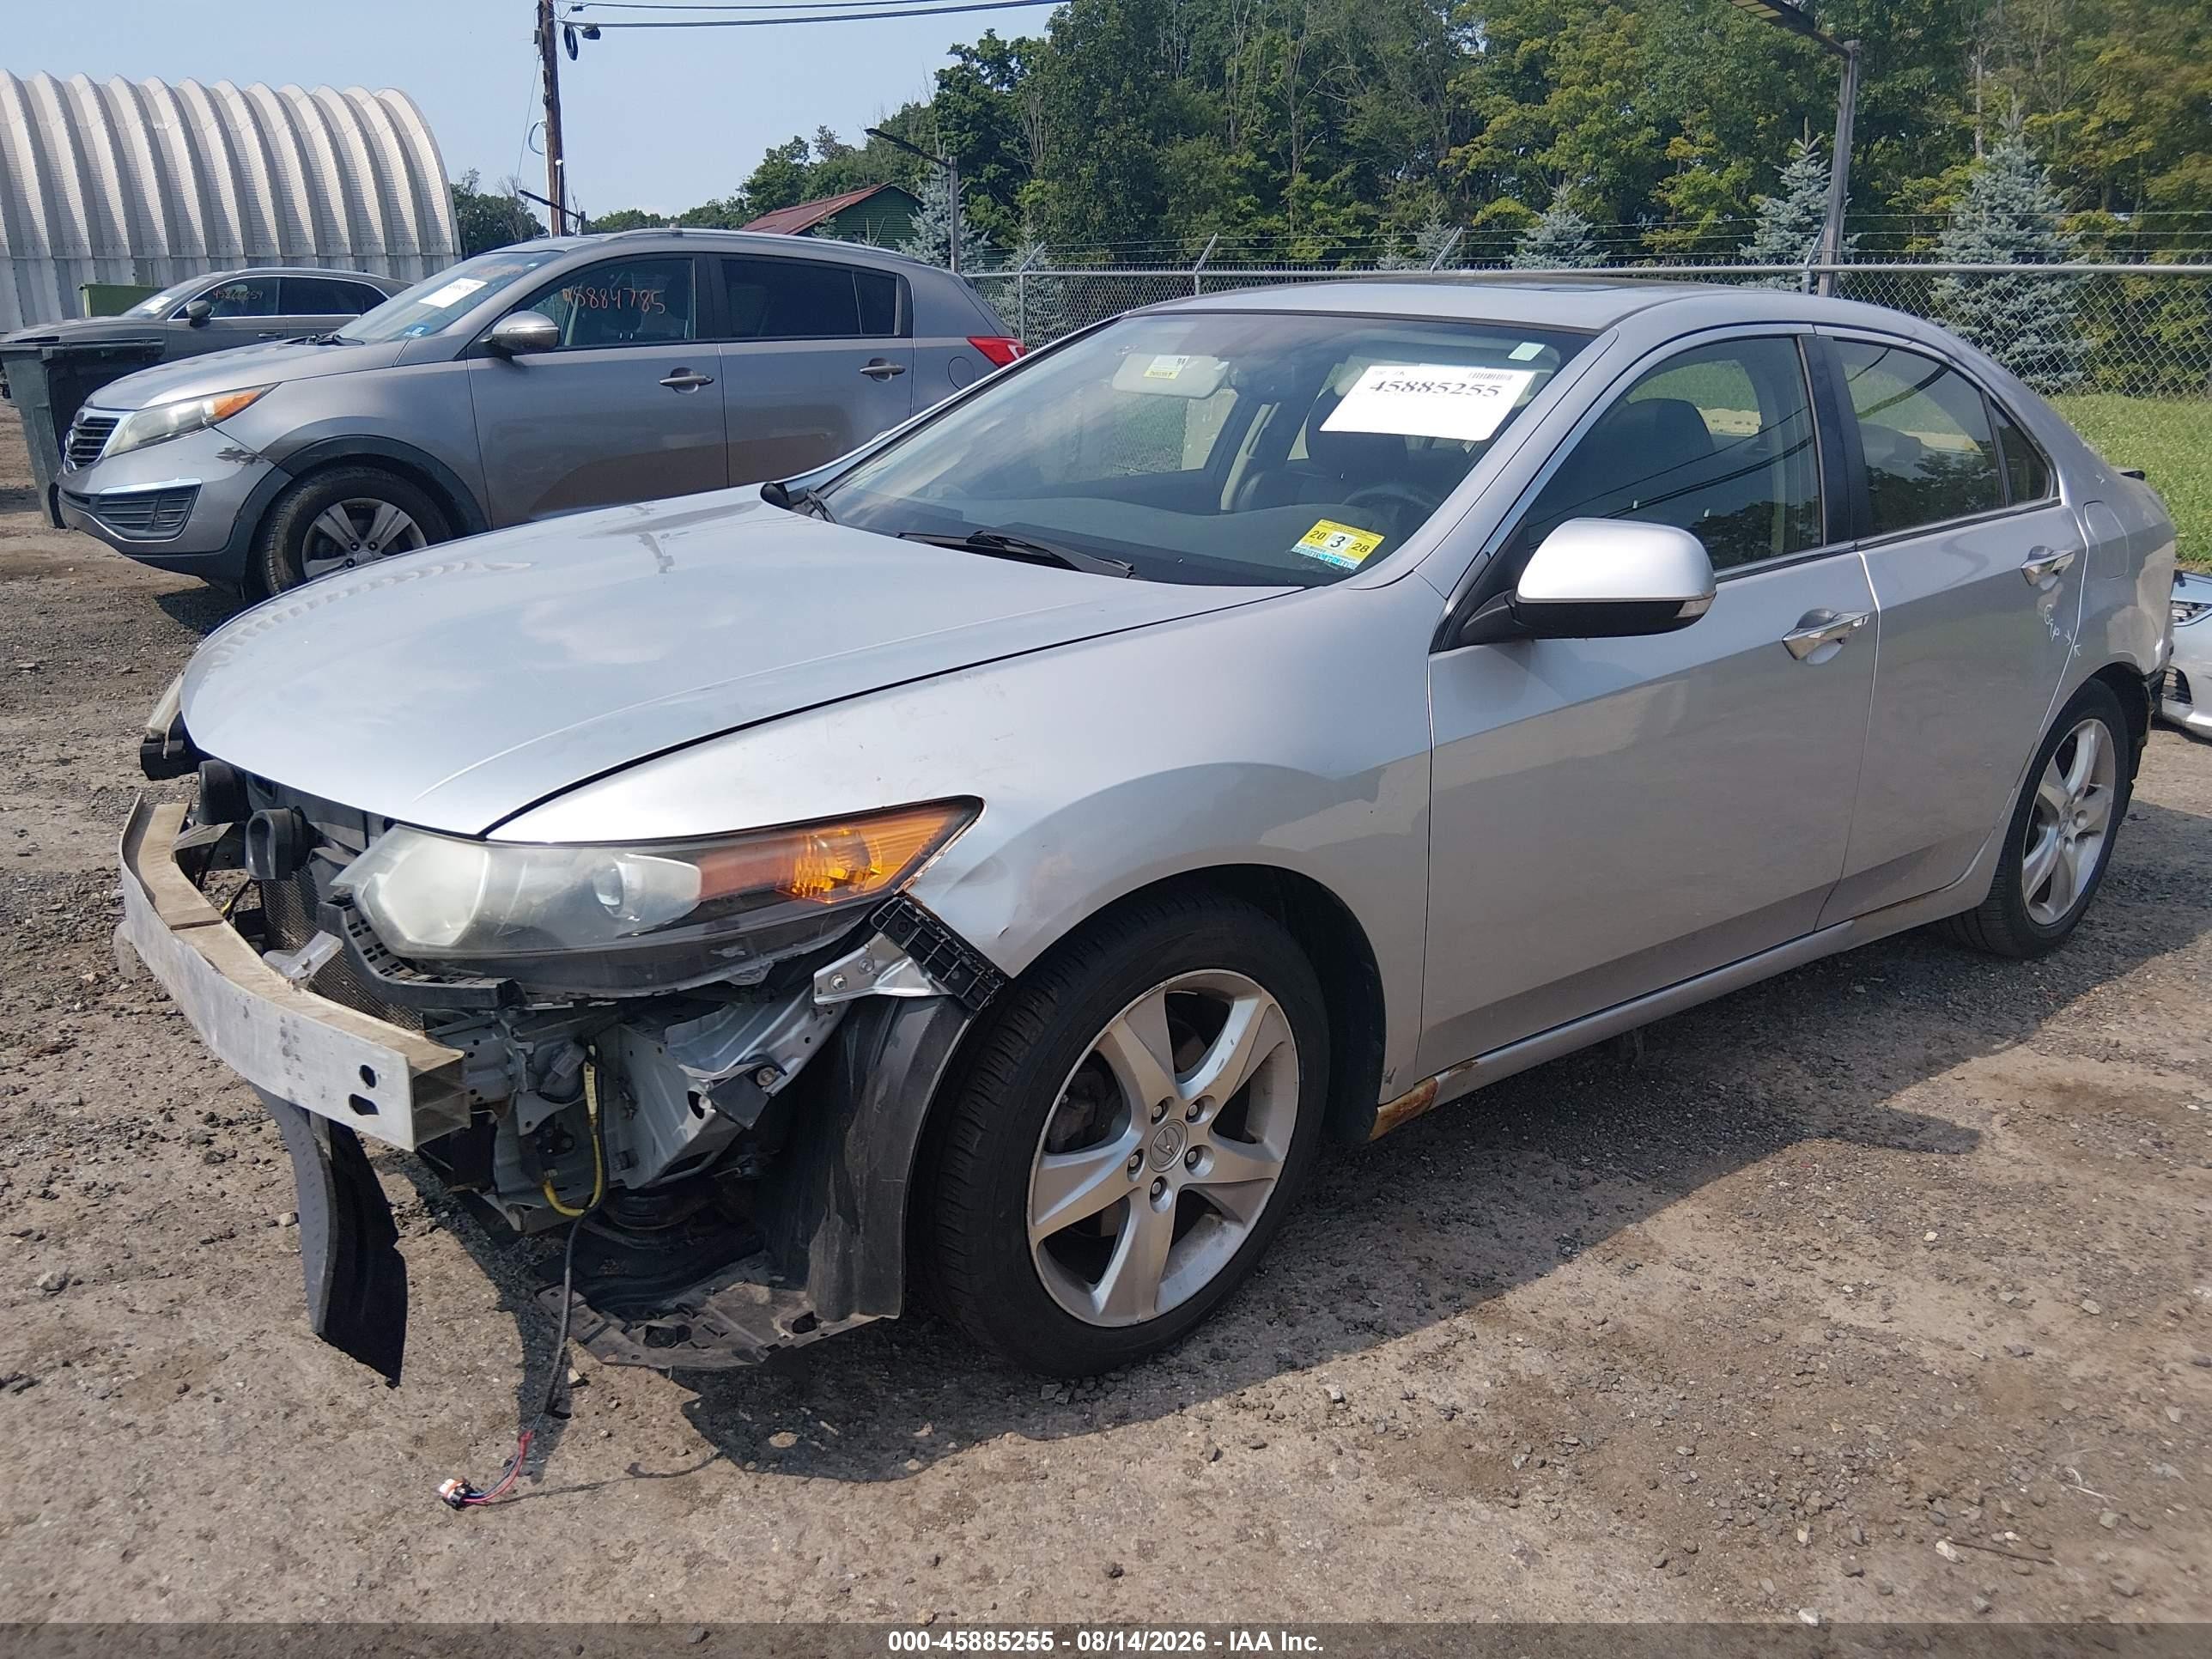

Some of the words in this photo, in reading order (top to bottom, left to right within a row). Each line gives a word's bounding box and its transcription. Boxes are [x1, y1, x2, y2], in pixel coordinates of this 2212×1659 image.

[1370, 380, 1502, 397] 45885255
[1310, 530, 1327, 540] 20
[1330, 536, 1346, 548] 3
[1351, 542, 1370, 553] 28
